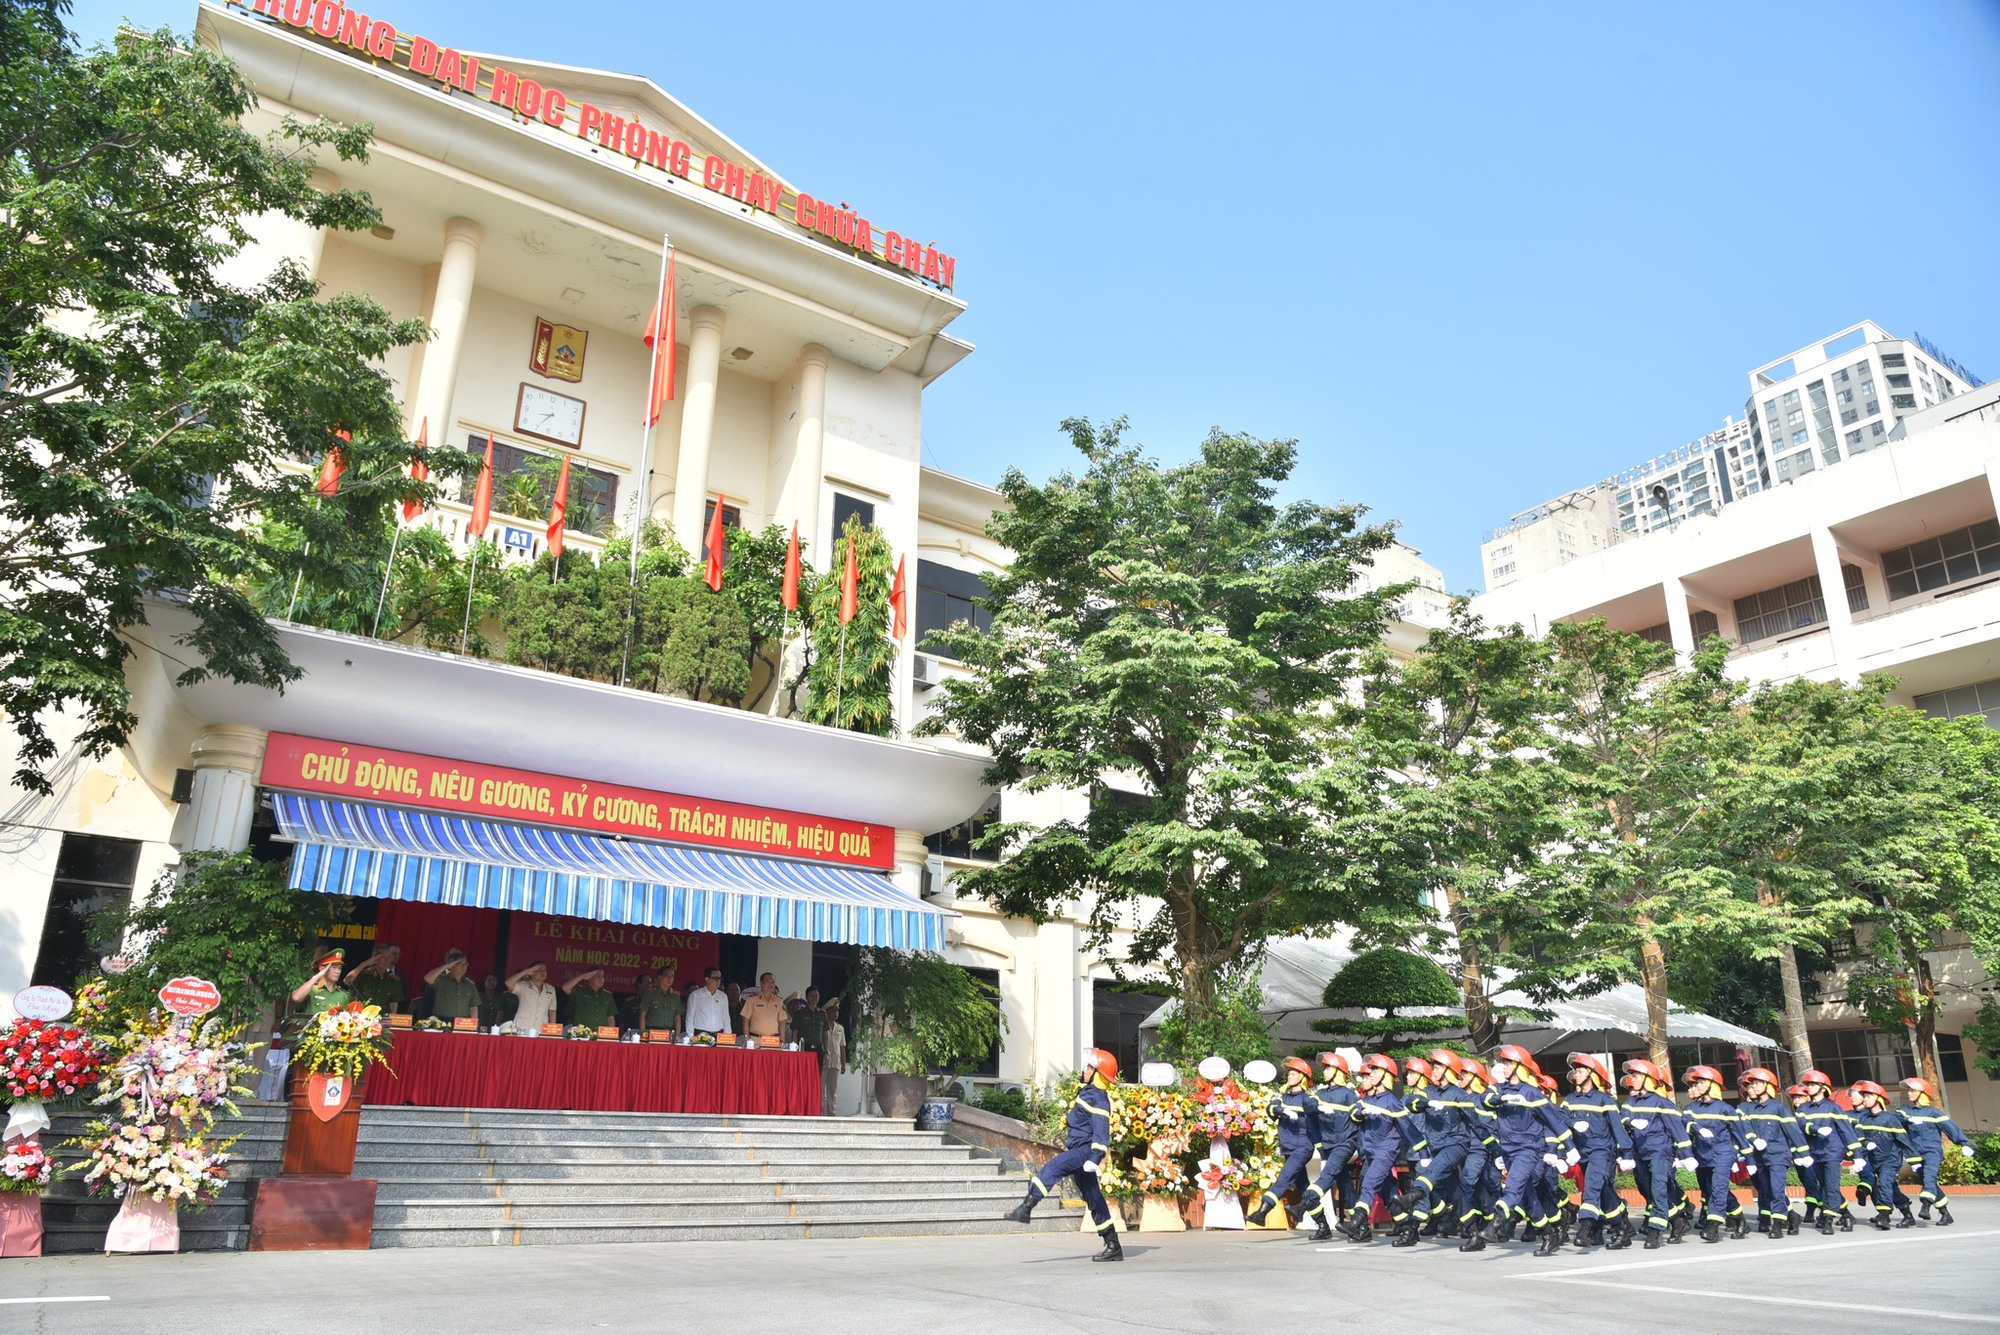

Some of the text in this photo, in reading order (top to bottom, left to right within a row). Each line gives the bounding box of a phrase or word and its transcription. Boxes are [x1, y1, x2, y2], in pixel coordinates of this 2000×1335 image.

[409, 35, 479, 94] ĐẠI
[491, 67, 567, 125] HỌC
[579, 102, 691, 178] PHÒNG
[703, 155, 784, 214] CHÁY
[885, 230, 956, 287] CHÁY
[508, 530, 528, 546] A1
[302, 746, 871, 858] CHỦ ĐỘNG, NÊU GƯƠNG, KỶ CƯƠNG, TRÁCH NHIỆM, HIỆU QUẢ
[570, 924, 625, 944] KHAI
[556, 946, 583, 964] NĂM
[613, 953, 640, 968] 2022
[651, 956, 678, 971] 2023
